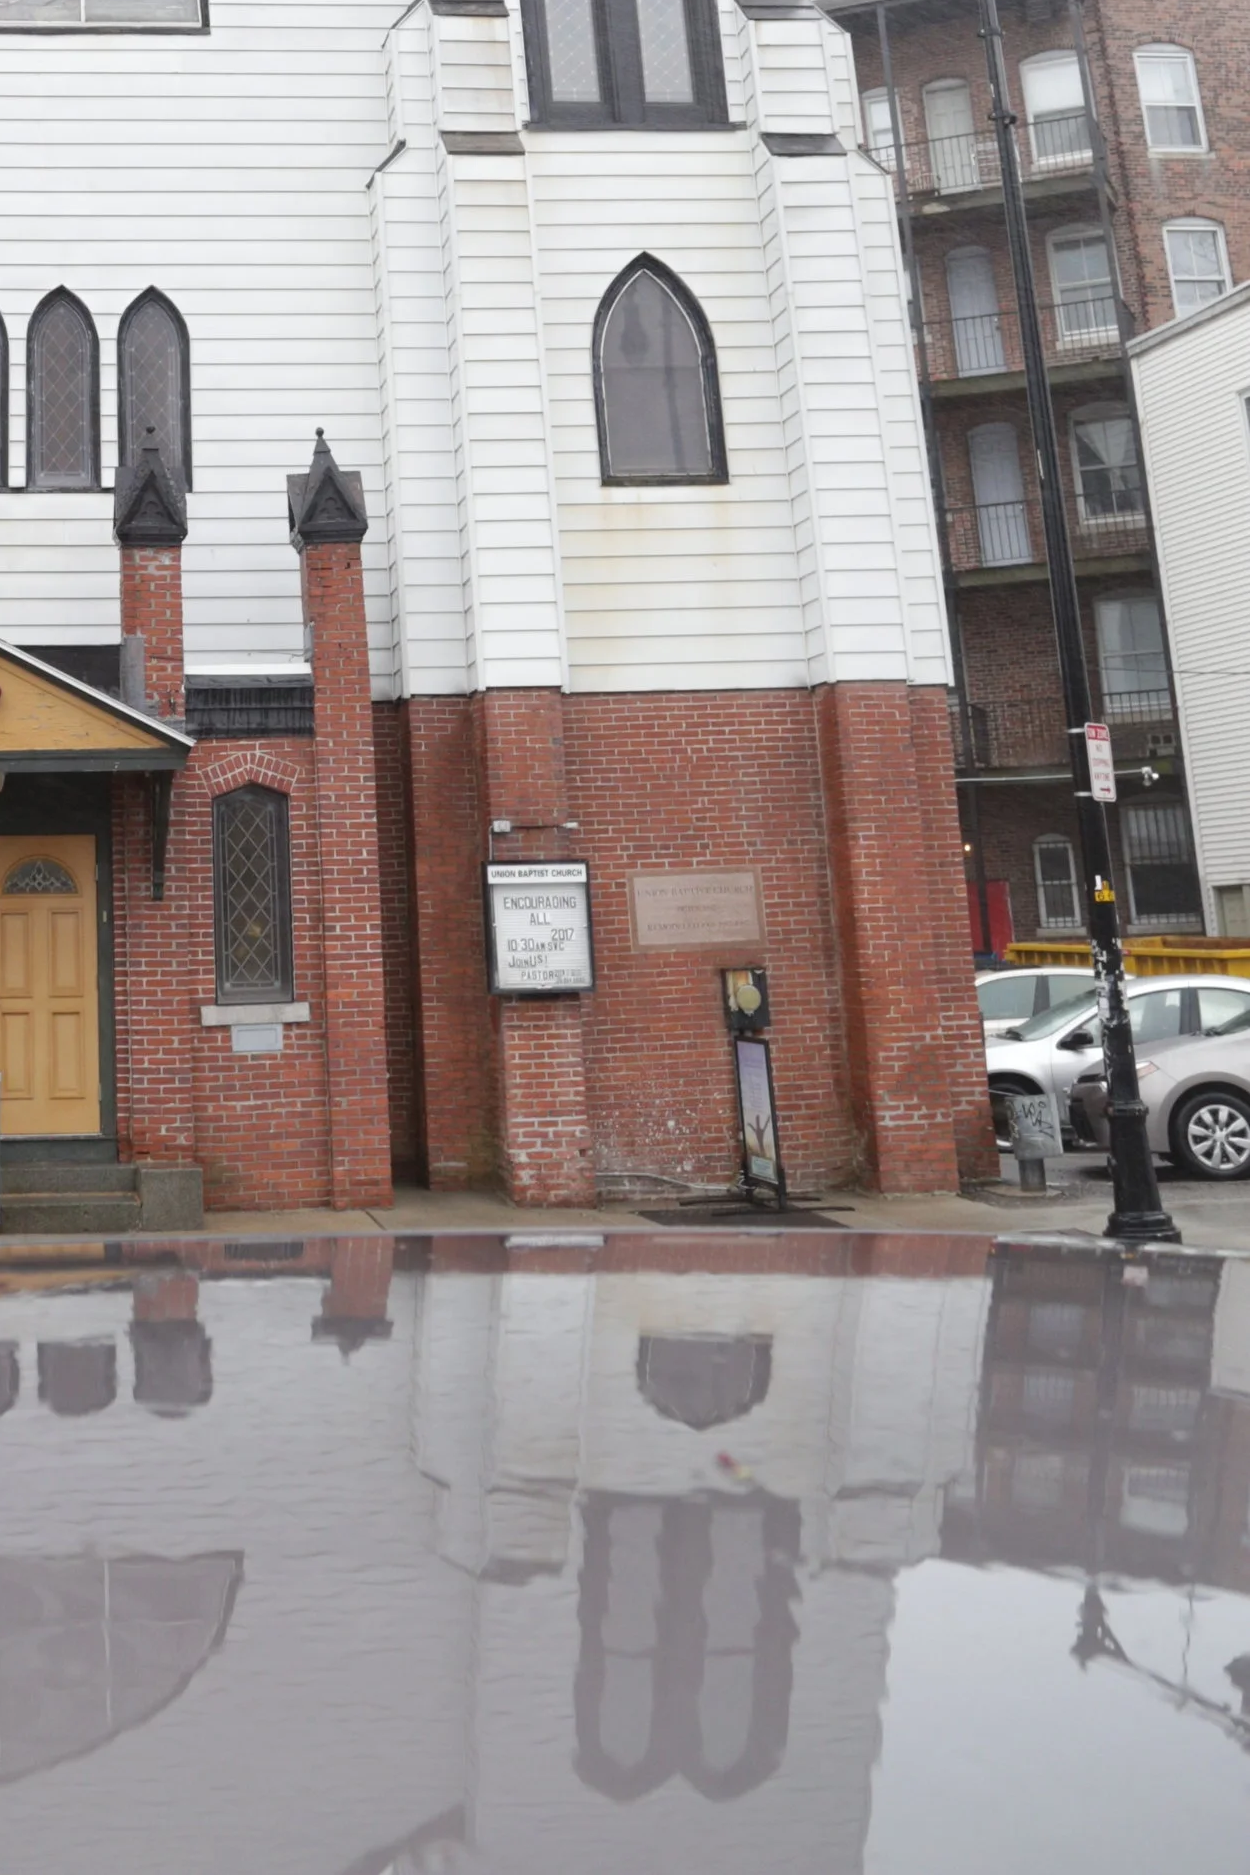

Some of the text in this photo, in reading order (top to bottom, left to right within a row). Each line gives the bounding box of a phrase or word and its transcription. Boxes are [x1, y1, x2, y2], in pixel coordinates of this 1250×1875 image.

[491, 868, 583, 878] UNION BAPTIST CHURCH
[529, 912, 551, 926] ALL
[551, 927, 574, 942] 2017
[521, 970, 554, 981] PASTOR
